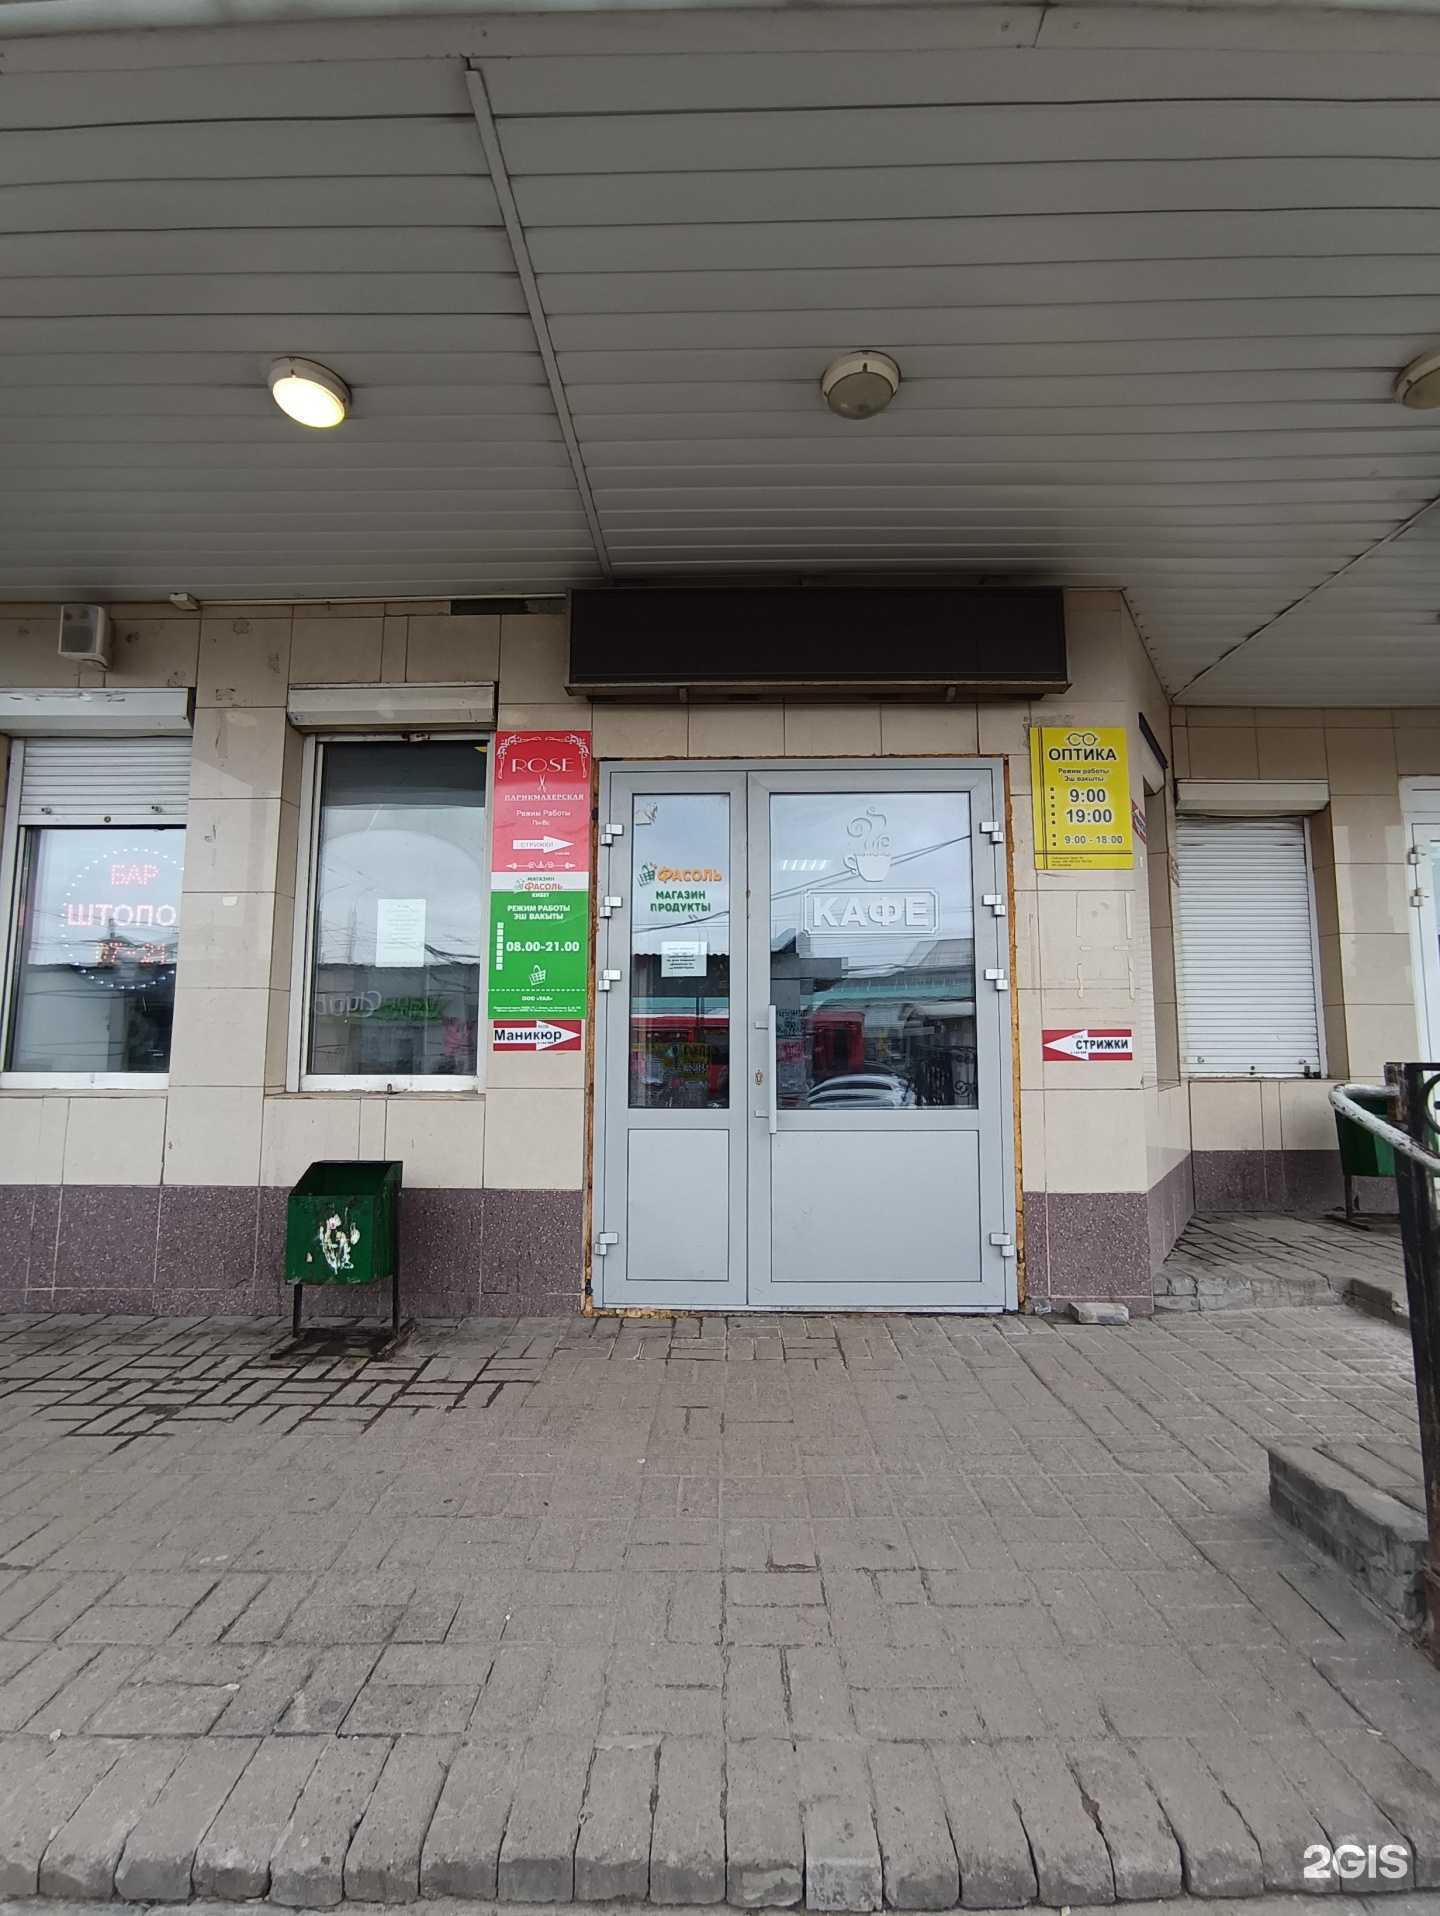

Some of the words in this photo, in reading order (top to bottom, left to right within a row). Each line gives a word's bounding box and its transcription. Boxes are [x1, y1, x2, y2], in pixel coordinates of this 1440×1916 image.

[1048, 748, 1117, 761] ОПТИКА
[511, 757, 575, 773] ROSE
[1058, 767, 1081, 775] Режим
[1069, 788, 1106, 803] 9:00
[1066, 808, 1113, 823] 19:00
[1064, 835, 1087, 845] 9:00
[1096, 835, 1123, 845] 18:00
[111, 864, 160, 886] БАР
[657, 866, 723, 884] ФАСОЛЬ
[524, 881, 563, 891] ФАСОЛЬ
[655, 890, 706, 901] МАГАЗИН
[507, 904, 536, 912] РЕЖИМ
[538, 904, 571, 912] РАБОТЫ
[650, 902, 711, 913] ПРОДУКТЫ
[812, 896, 930, 928] КАФЕ
[67, 904, 177, 927] ШТОПО
[506, 941, 580, 952] 08.00-21.00
[494, 1029, 562, 1043] Маникюр
[1075, 1040, 1128, 1050] СТРИЖКИ
